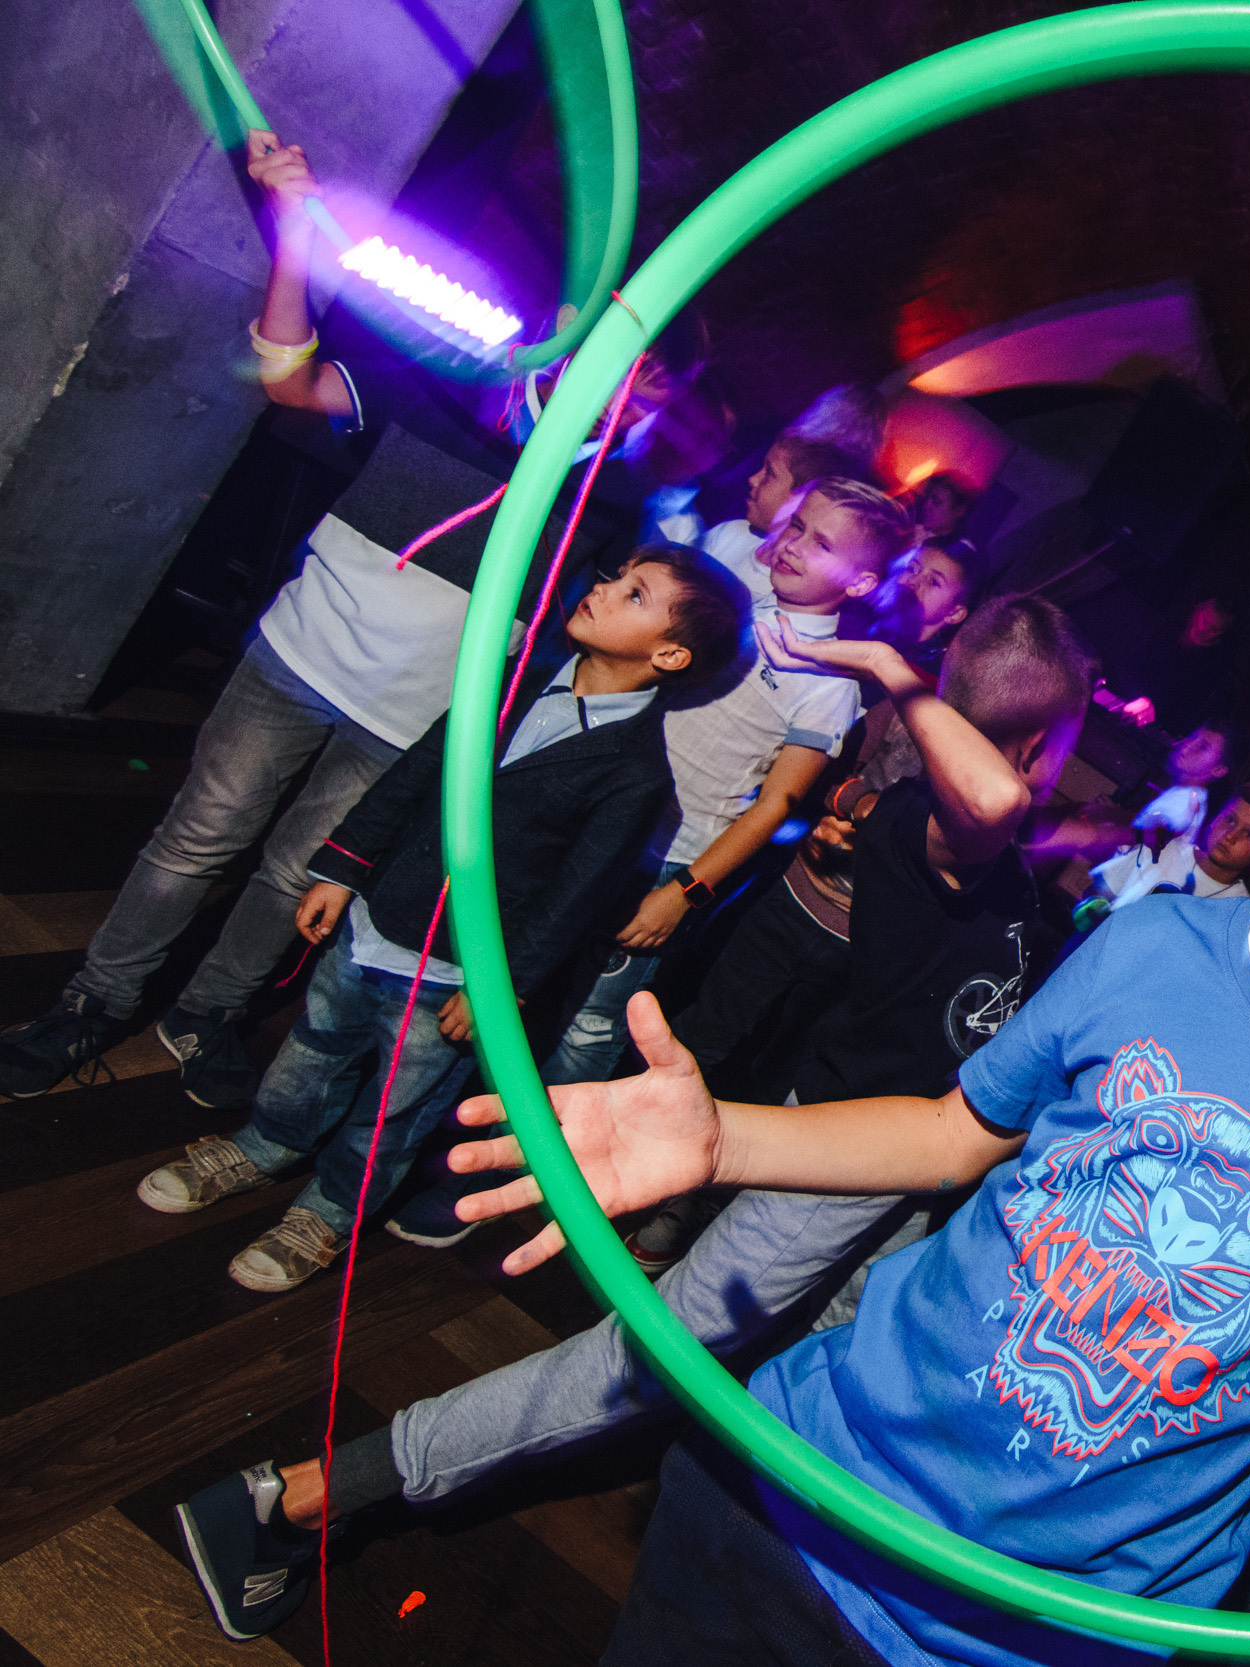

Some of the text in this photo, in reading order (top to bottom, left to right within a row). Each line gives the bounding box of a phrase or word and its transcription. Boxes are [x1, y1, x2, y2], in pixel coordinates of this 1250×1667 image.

[965, 1299, 1150, 1488] PARIS
[1020, 1213, 1220, 1406] KENZO
[243, 1567, 289, 1608] N
